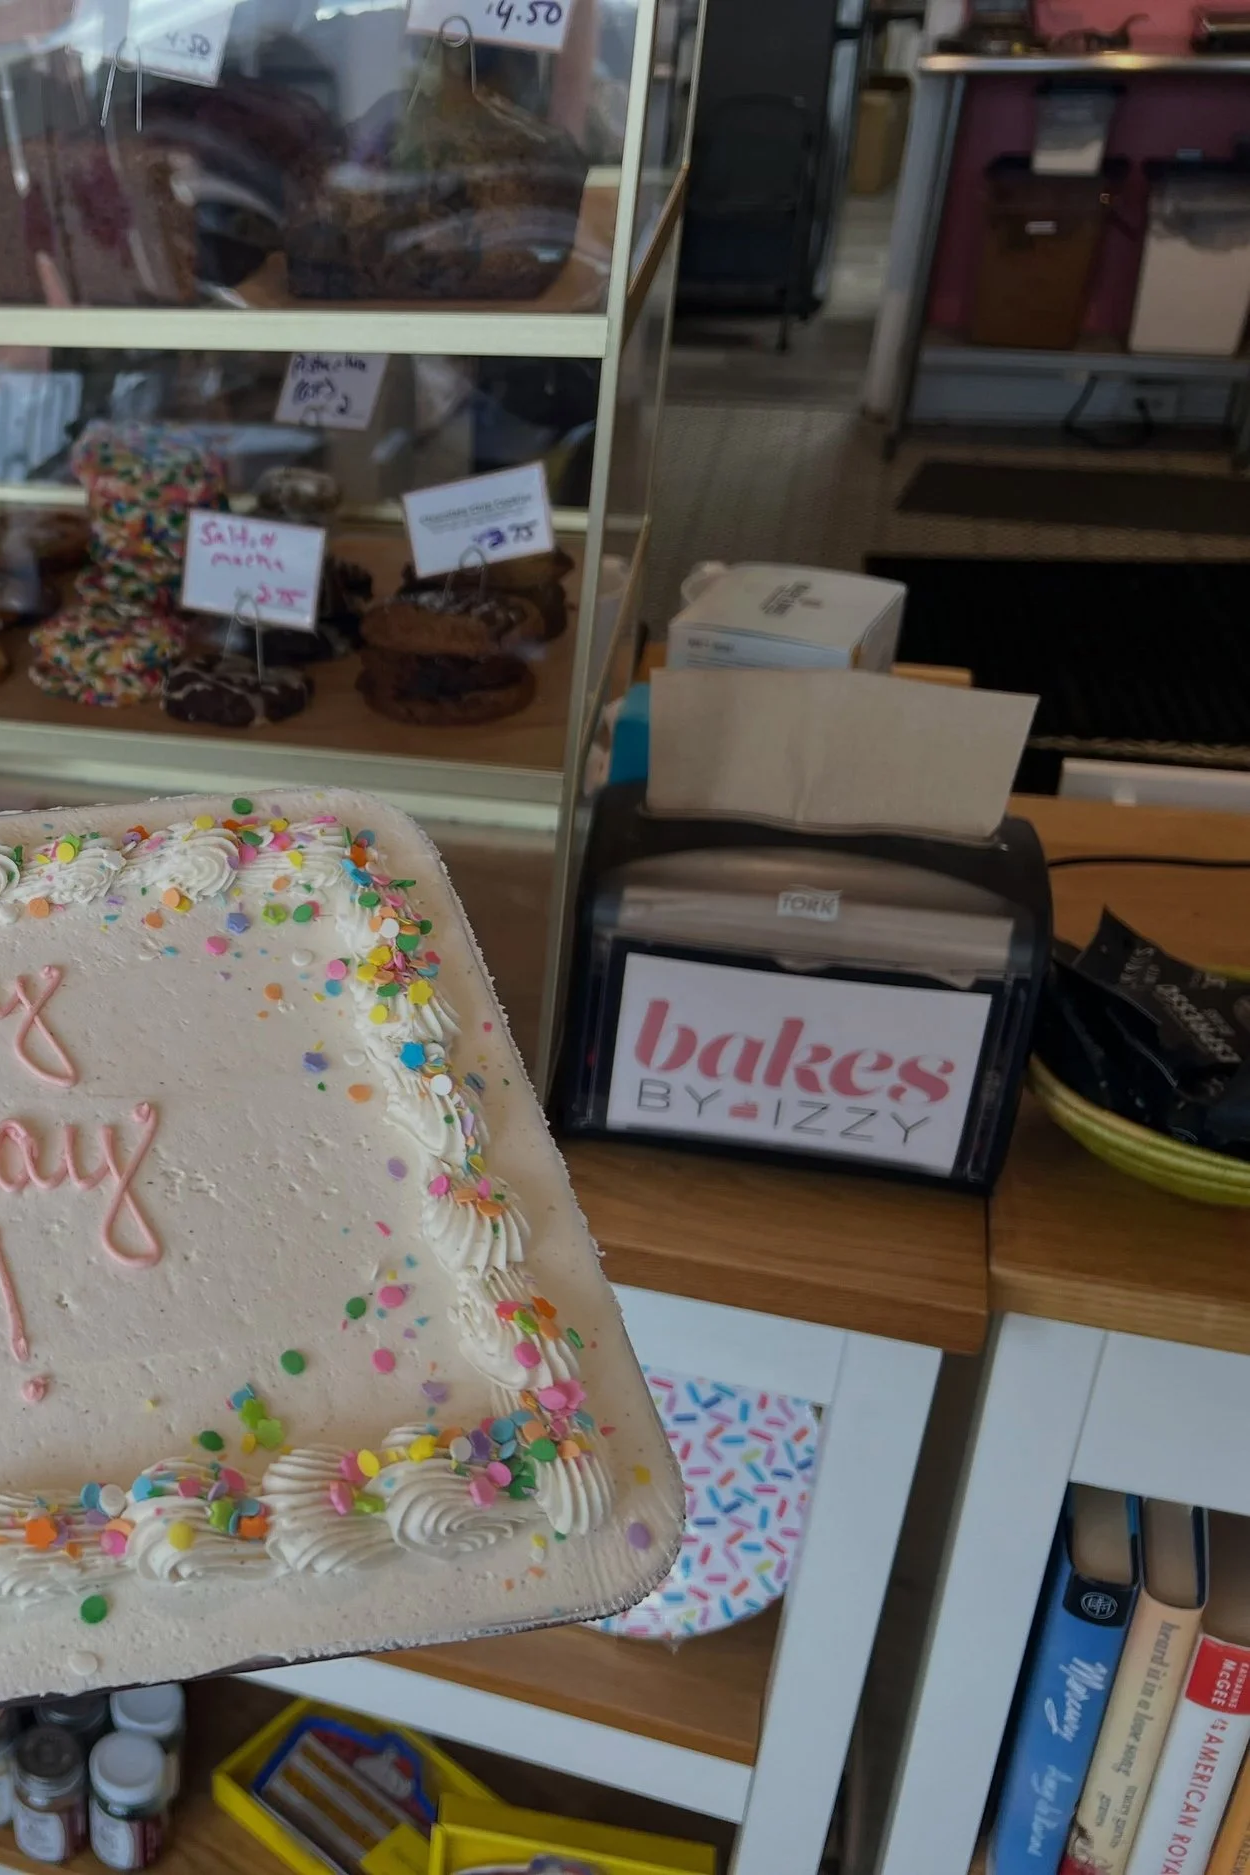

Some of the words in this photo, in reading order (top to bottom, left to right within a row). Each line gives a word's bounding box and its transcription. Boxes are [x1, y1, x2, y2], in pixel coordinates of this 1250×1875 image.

[634, 998, 955, 1103] bakes
[637, 1078, 722, 1118] BY
[773, 1098, 931, 1144] IZZY
[1211, 1658, 1237, 1706] McGEE
[1177, 1732, 1225, 1829] AMERICAN
